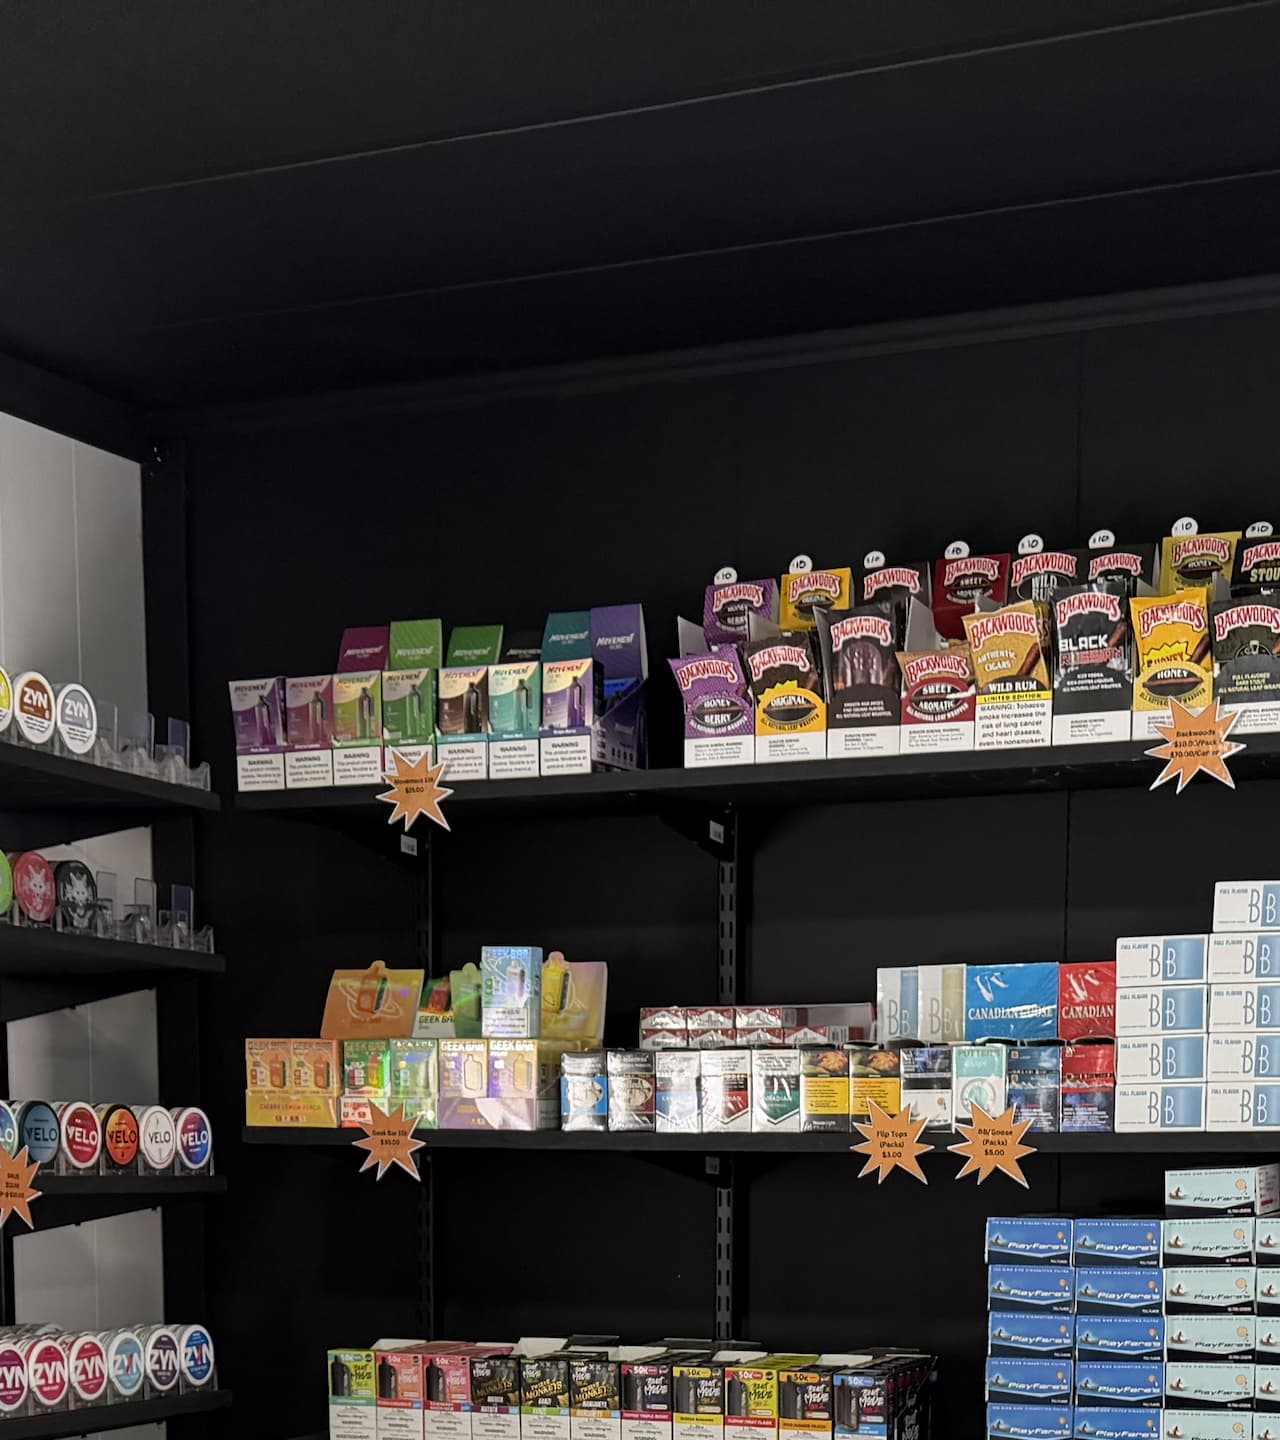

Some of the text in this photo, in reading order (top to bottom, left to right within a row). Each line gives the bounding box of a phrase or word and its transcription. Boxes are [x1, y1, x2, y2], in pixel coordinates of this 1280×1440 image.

[945, 557, 999, 584] BACKWOODS
[1012, 552, 1077, 585] BACKWOODS
[790, 571, 840, 600] BACKWOODS
[864, 568, 920, 598] BACKWOODS
[713, 583, 764, 608] BACKWOODS
[831, 616, 892, 650] BACKWOODS
[971, 613, 1037, 651] BACKWOODS
[1059, 635, 1108, 650] BLACK
[676, 660, 736, 688] BACKWOODS
[749, 646, 808, 678] BACKWOODS
[907, 655, 971, 684] BACKWOODS
[985, 661, 1011, 672] CIGARS
[989, 680, 1037, 692] WILD RUM
[23, 687, 49, 710] ZYN
[64, 699, 89, 720] ZYN
[770, 694, 806, 708] ORIGINAL
[1003, 721, 1018, 730] lung
[24, 1126, 58, 1142] VELO
[67, 1124, 99, 1144] VELO
[877, 1130, 907, 1139] Flip Tops
[879, 1141, 905, 1149] (Packs)
[74, 1358, 106, 1383] ZYN
